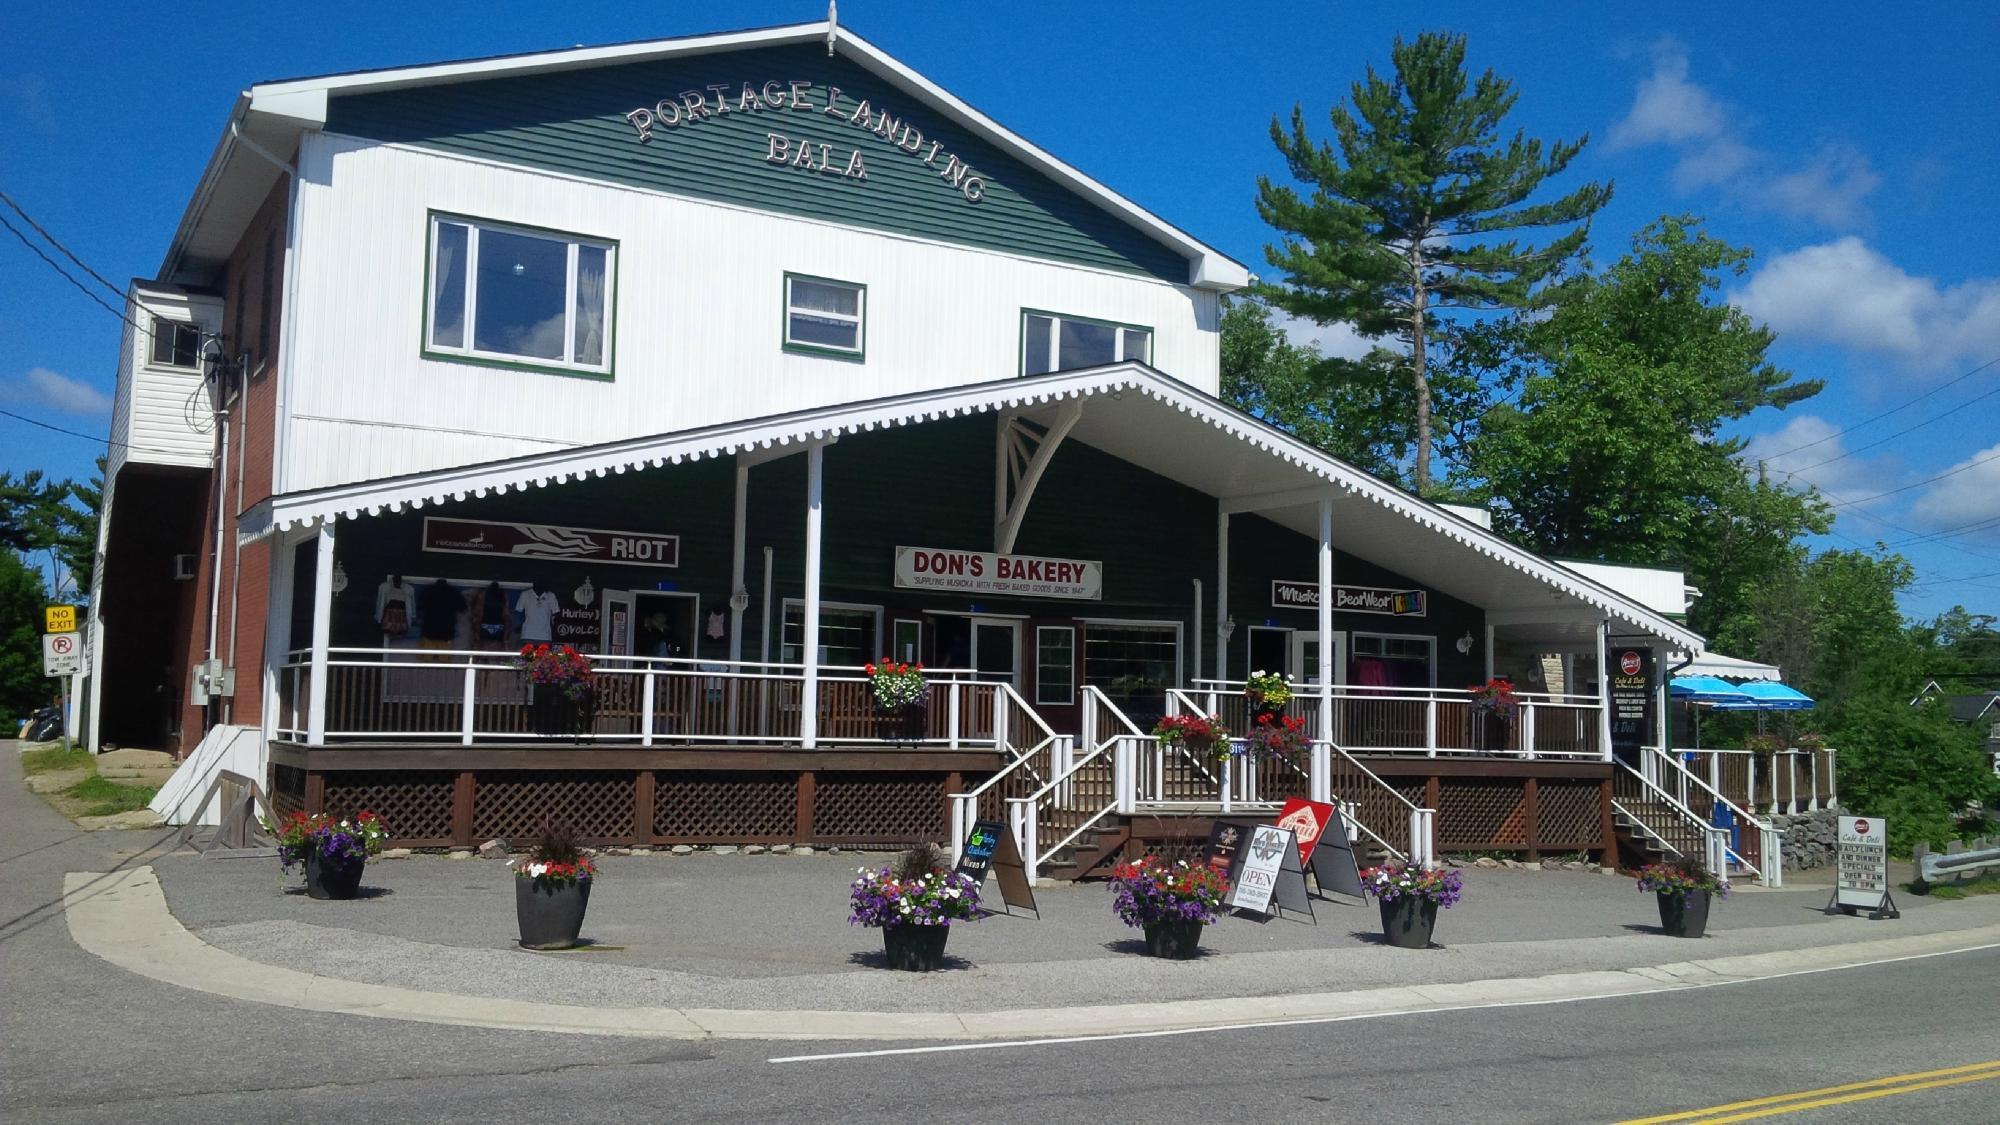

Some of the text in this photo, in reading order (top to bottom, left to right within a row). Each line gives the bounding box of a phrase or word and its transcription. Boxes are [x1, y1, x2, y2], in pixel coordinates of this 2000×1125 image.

[626, 80, 986, 203] PORTAGE LANDING
[767, 133, 868, 179] BALA
[913, 551, 1087, 584] DON'S BAKERY
[947, 578, 974, 588] MUSKOKA
[976, 579, 991, 589] WITH
[992, 581, 1010, 590] FRESH
[1012, 582, 1030, 592] BAKED
[1032, 583, 1051, 593] GOODS
[1054, 585, 1069, 594] SINCE
[1278, 585, 1392, 608] Musko BearWear
[52, 610, 69, 618] NO
[562, 608, 594, 620] Hurley
[49, 620, 72, 630] EXIT
[569, 625, 600, 635] VOLCO
[1839, 845, 1860, 853] DAILY
[1842, 862, 1876, 872] SPECIALS
[1242, 870, 1275, 887] OPEN
